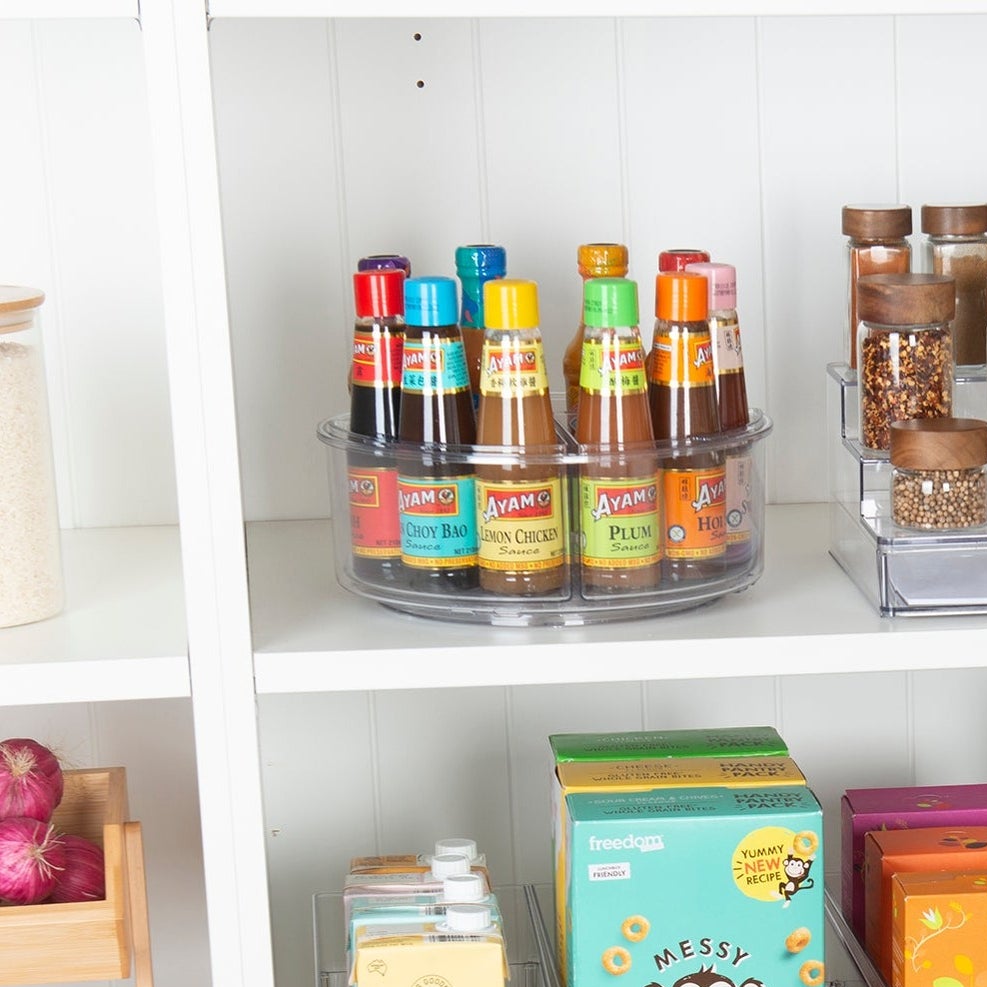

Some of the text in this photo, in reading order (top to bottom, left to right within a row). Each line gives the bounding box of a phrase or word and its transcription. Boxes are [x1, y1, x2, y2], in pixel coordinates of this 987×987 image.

[691, 478, 726, 512] AYA
[483, 493, 534, 523] AYAM
[592, 488, 646, 521] AYAM
[406, 521, 468, 538] CHOY BAO
[480, 526, 559, 544] LEMON CHICKEN
[609, 525, 652, 541] PLUM
[406, 540, 441, 551] Sauce
[499, 546, 540, 555] Sauce
[611, 543, 650, 552] Sauce
[589, 834, 665, 852] freedom
[741, 844, 785, 859] YUMMY
[744, 857, 782, 874] NEW
[746, 871, 782, 885] RECIPE
[652, 937, 751, 972] MESSY
